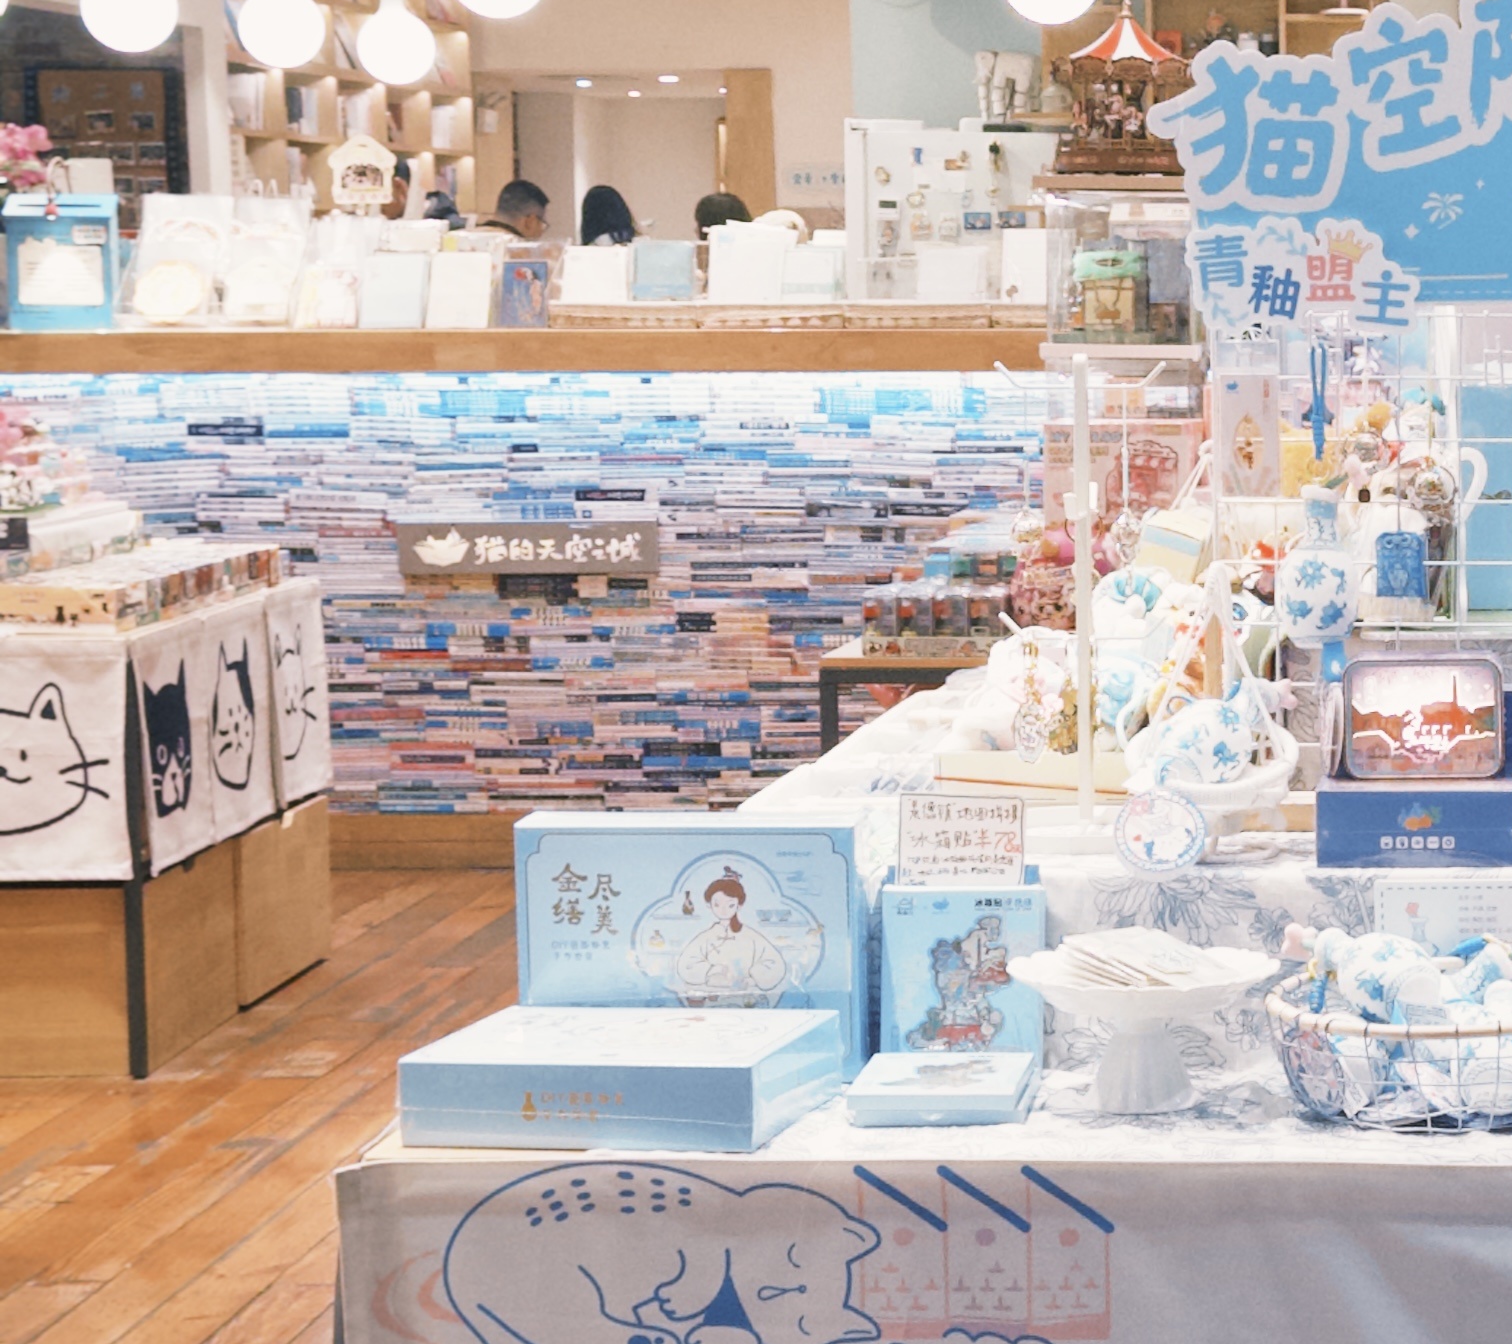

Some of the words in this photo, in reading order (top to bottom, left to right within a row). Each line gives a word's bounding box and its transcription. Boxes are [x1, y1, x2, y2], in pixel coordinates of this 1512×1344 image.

[1194, 234, 1410, 327] 青釉盟主
[473, 532, 642, 565] 猫的天空之城
